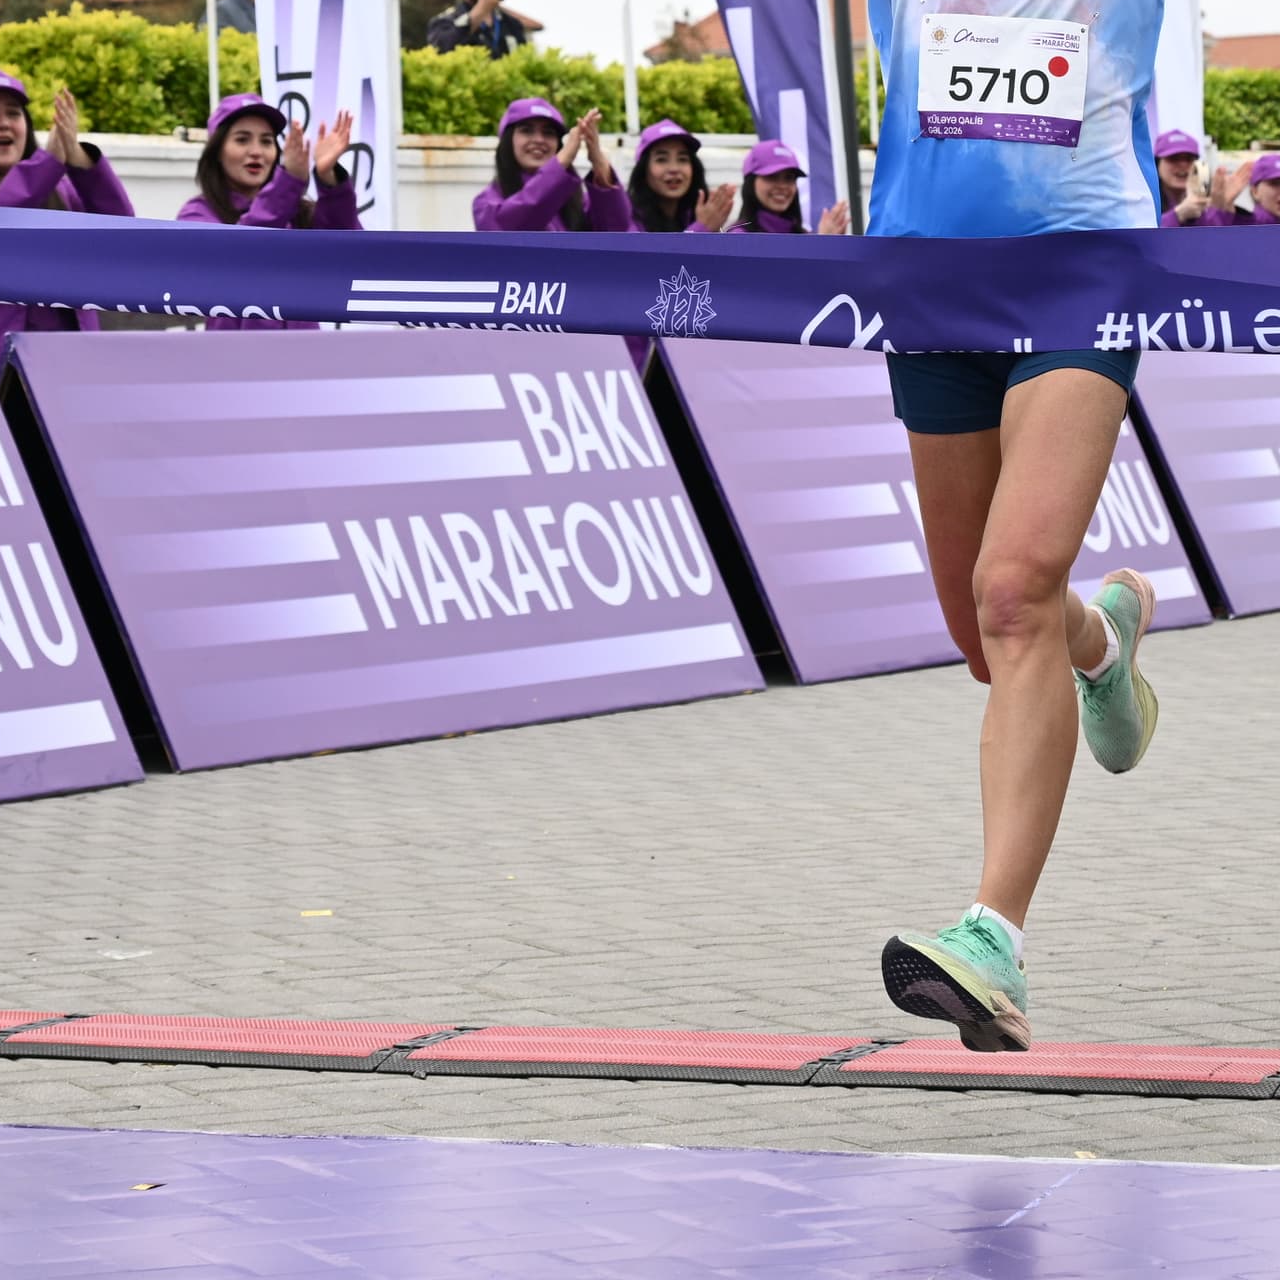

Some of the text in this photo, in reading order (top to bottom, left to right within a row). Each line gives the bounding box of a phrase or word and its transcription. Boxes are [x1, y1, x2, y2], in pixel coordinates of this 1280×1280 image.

[969, 34, 999, 44] Azercell
[1041, 39, 1080, 50] MARAFONU
[948, 66, 1050, 105] 5710
[944, 126, 963, 135] 2026
[500, 282, 567, 315] BAKI
[510, 369, 668, 475] BAKI
[343, 495, 714, 630] MARAFONU
